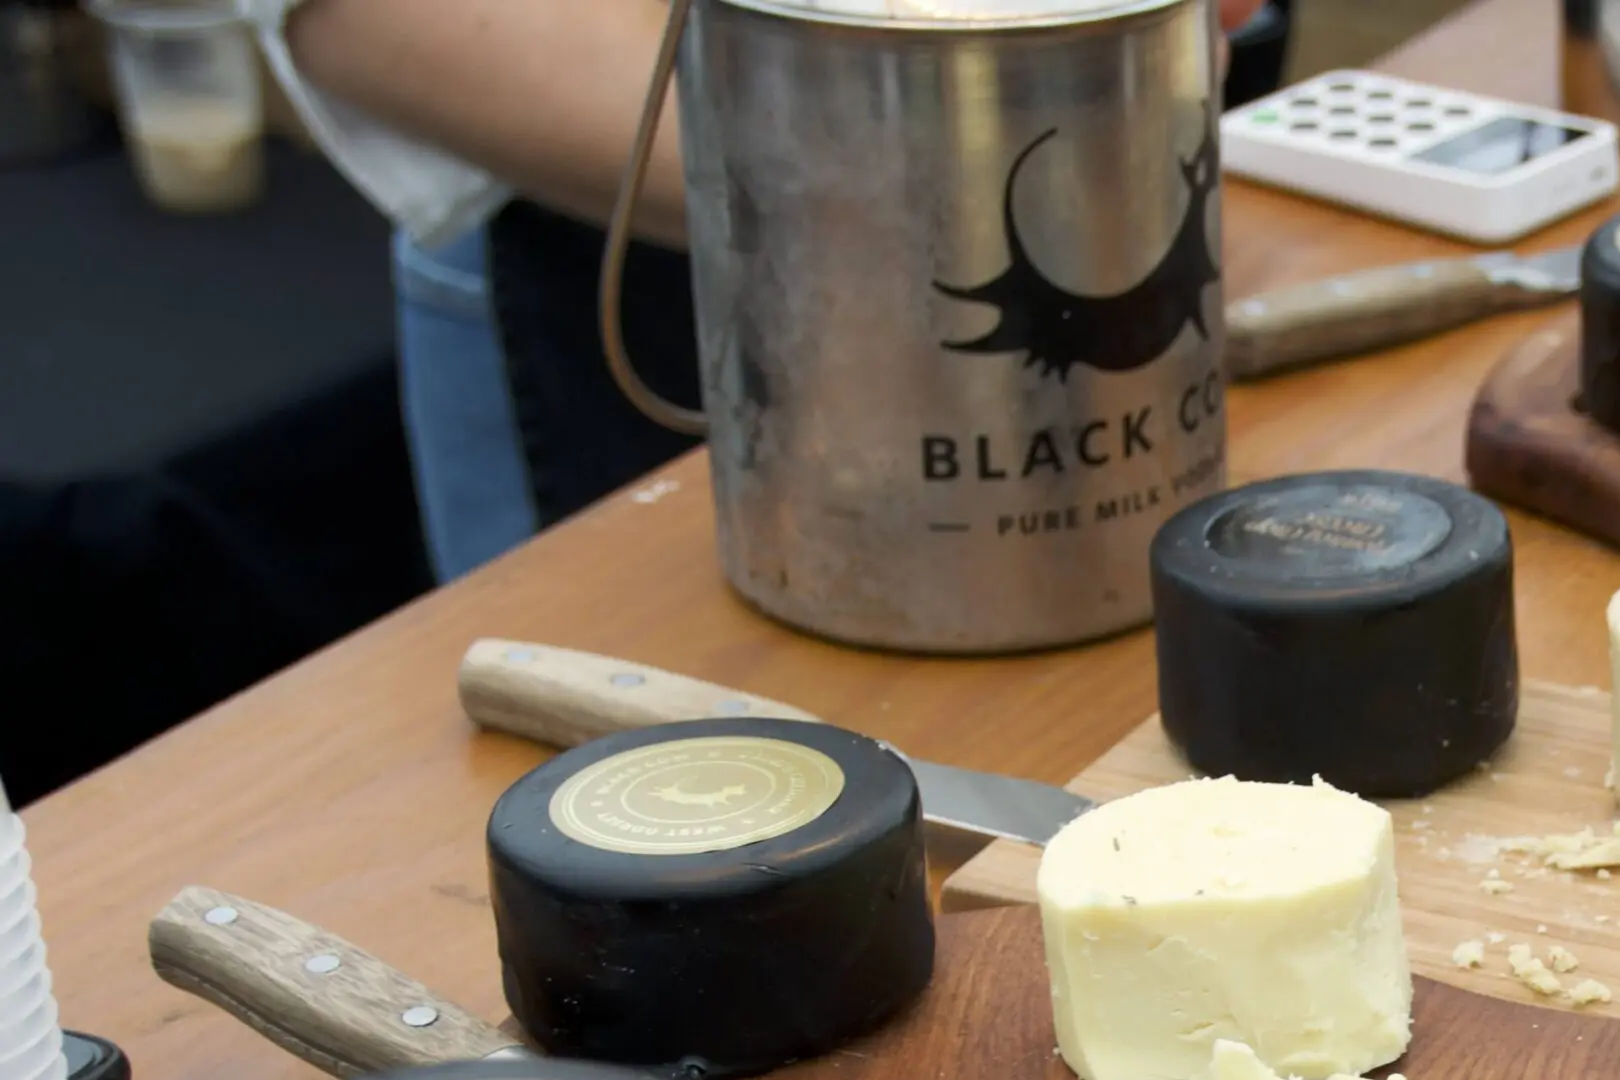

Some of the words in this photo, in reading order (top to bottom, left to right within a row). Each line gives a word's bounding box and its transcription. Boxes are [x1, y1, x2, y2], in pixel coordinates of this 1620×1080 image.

[921, 405, 1153, 481] BLACK
[997, 506, 1080, 537] PURE
[1095, 486, 1160, 521] MILK
